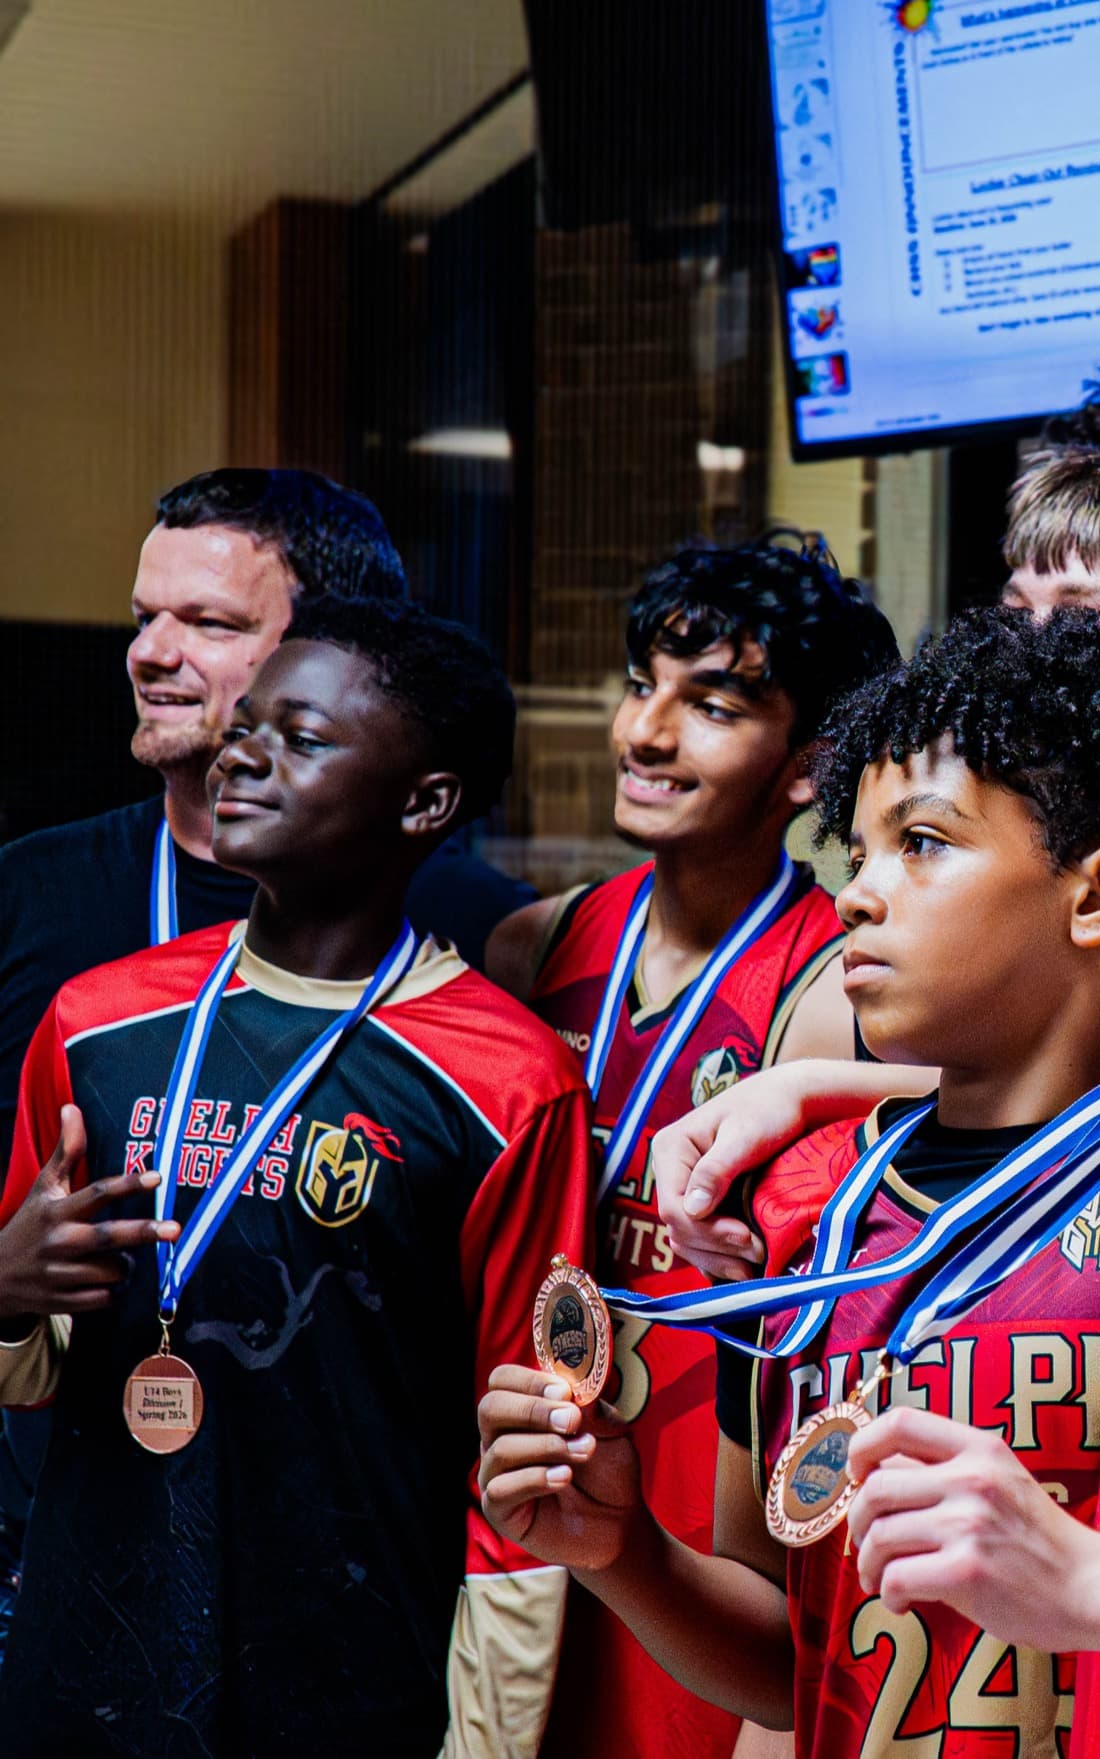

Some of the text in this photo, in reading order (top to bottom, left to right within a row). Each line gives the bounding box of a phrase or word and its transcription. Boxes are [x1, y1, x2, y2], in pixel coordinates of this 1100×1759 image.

[128, 1096, 302, 1155] GELH
[124, 1142, 290, 1200] KIGS
[849, 1593, 1075, 1759] 24
